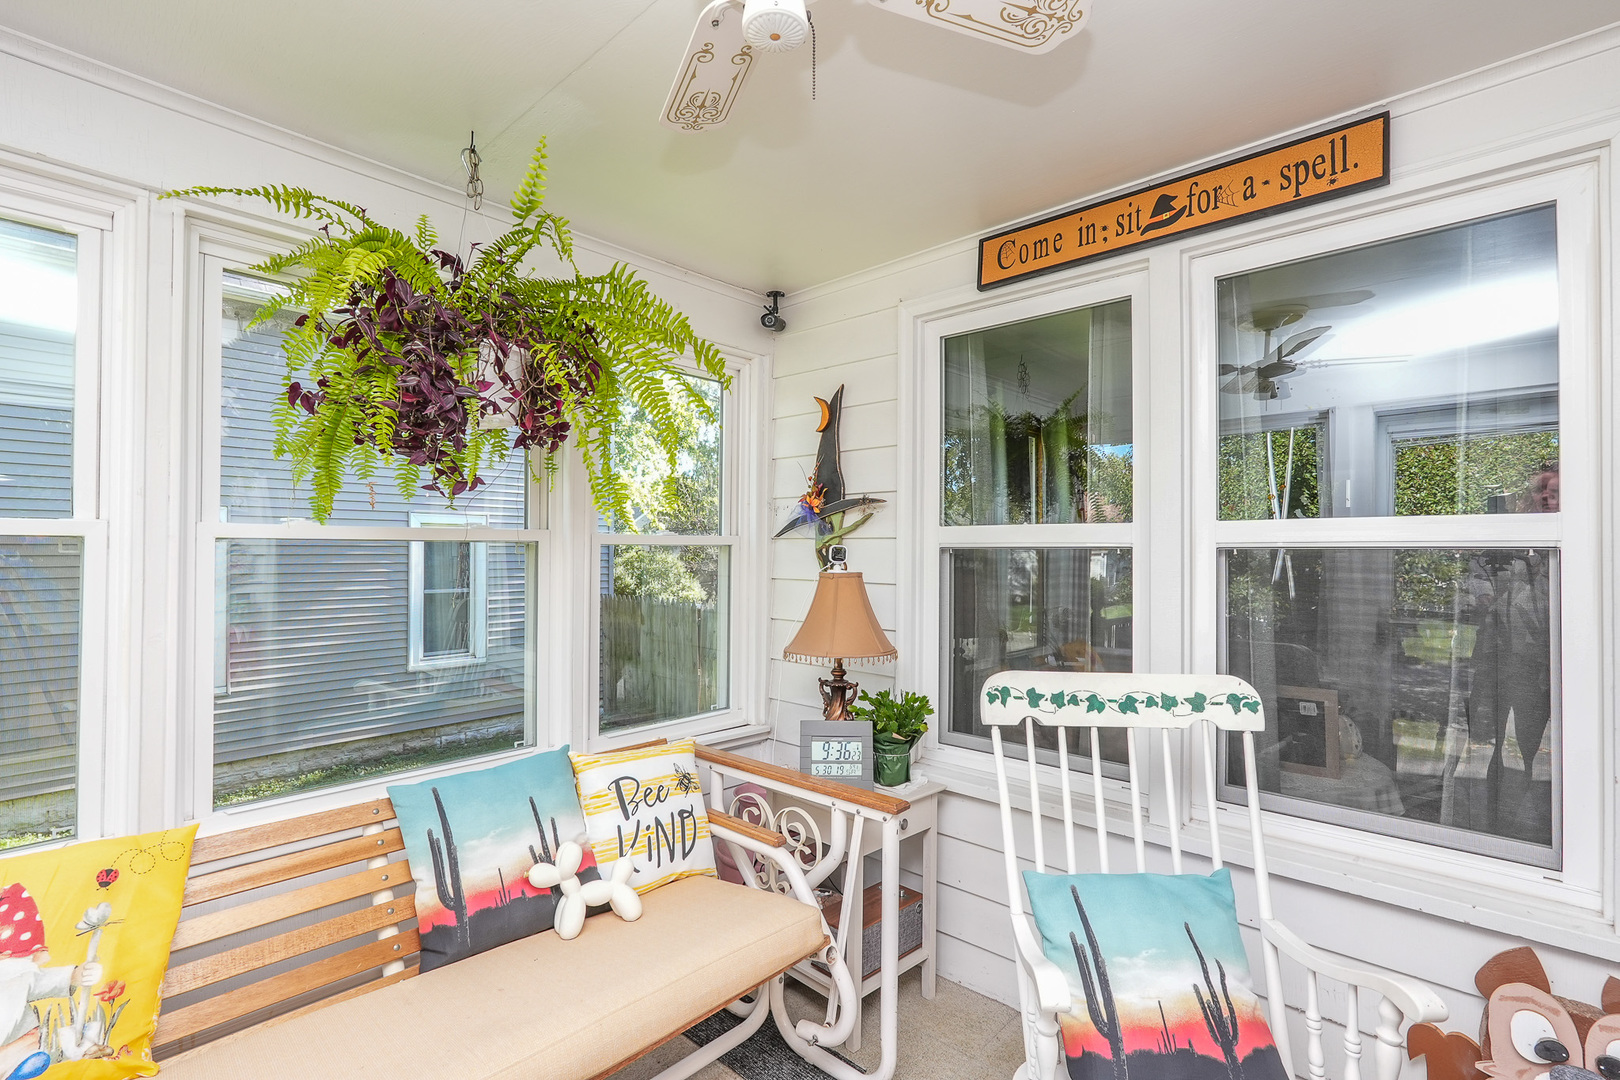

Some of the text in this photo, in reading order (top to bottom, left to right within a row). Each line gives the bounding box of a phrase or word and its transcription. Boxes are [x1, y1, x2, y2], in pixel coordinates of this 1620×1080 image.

[997, 231, 1063, 269] Come
[1115, 202, 1142, 237] sit
[1185, 181, 1223, 218] for
[1243, 175, 1257, 201] a
[822, 741, 851, 760] 9:36
[823, 765, 832, 775] 30
[607, 775, 670, 822] Bee
